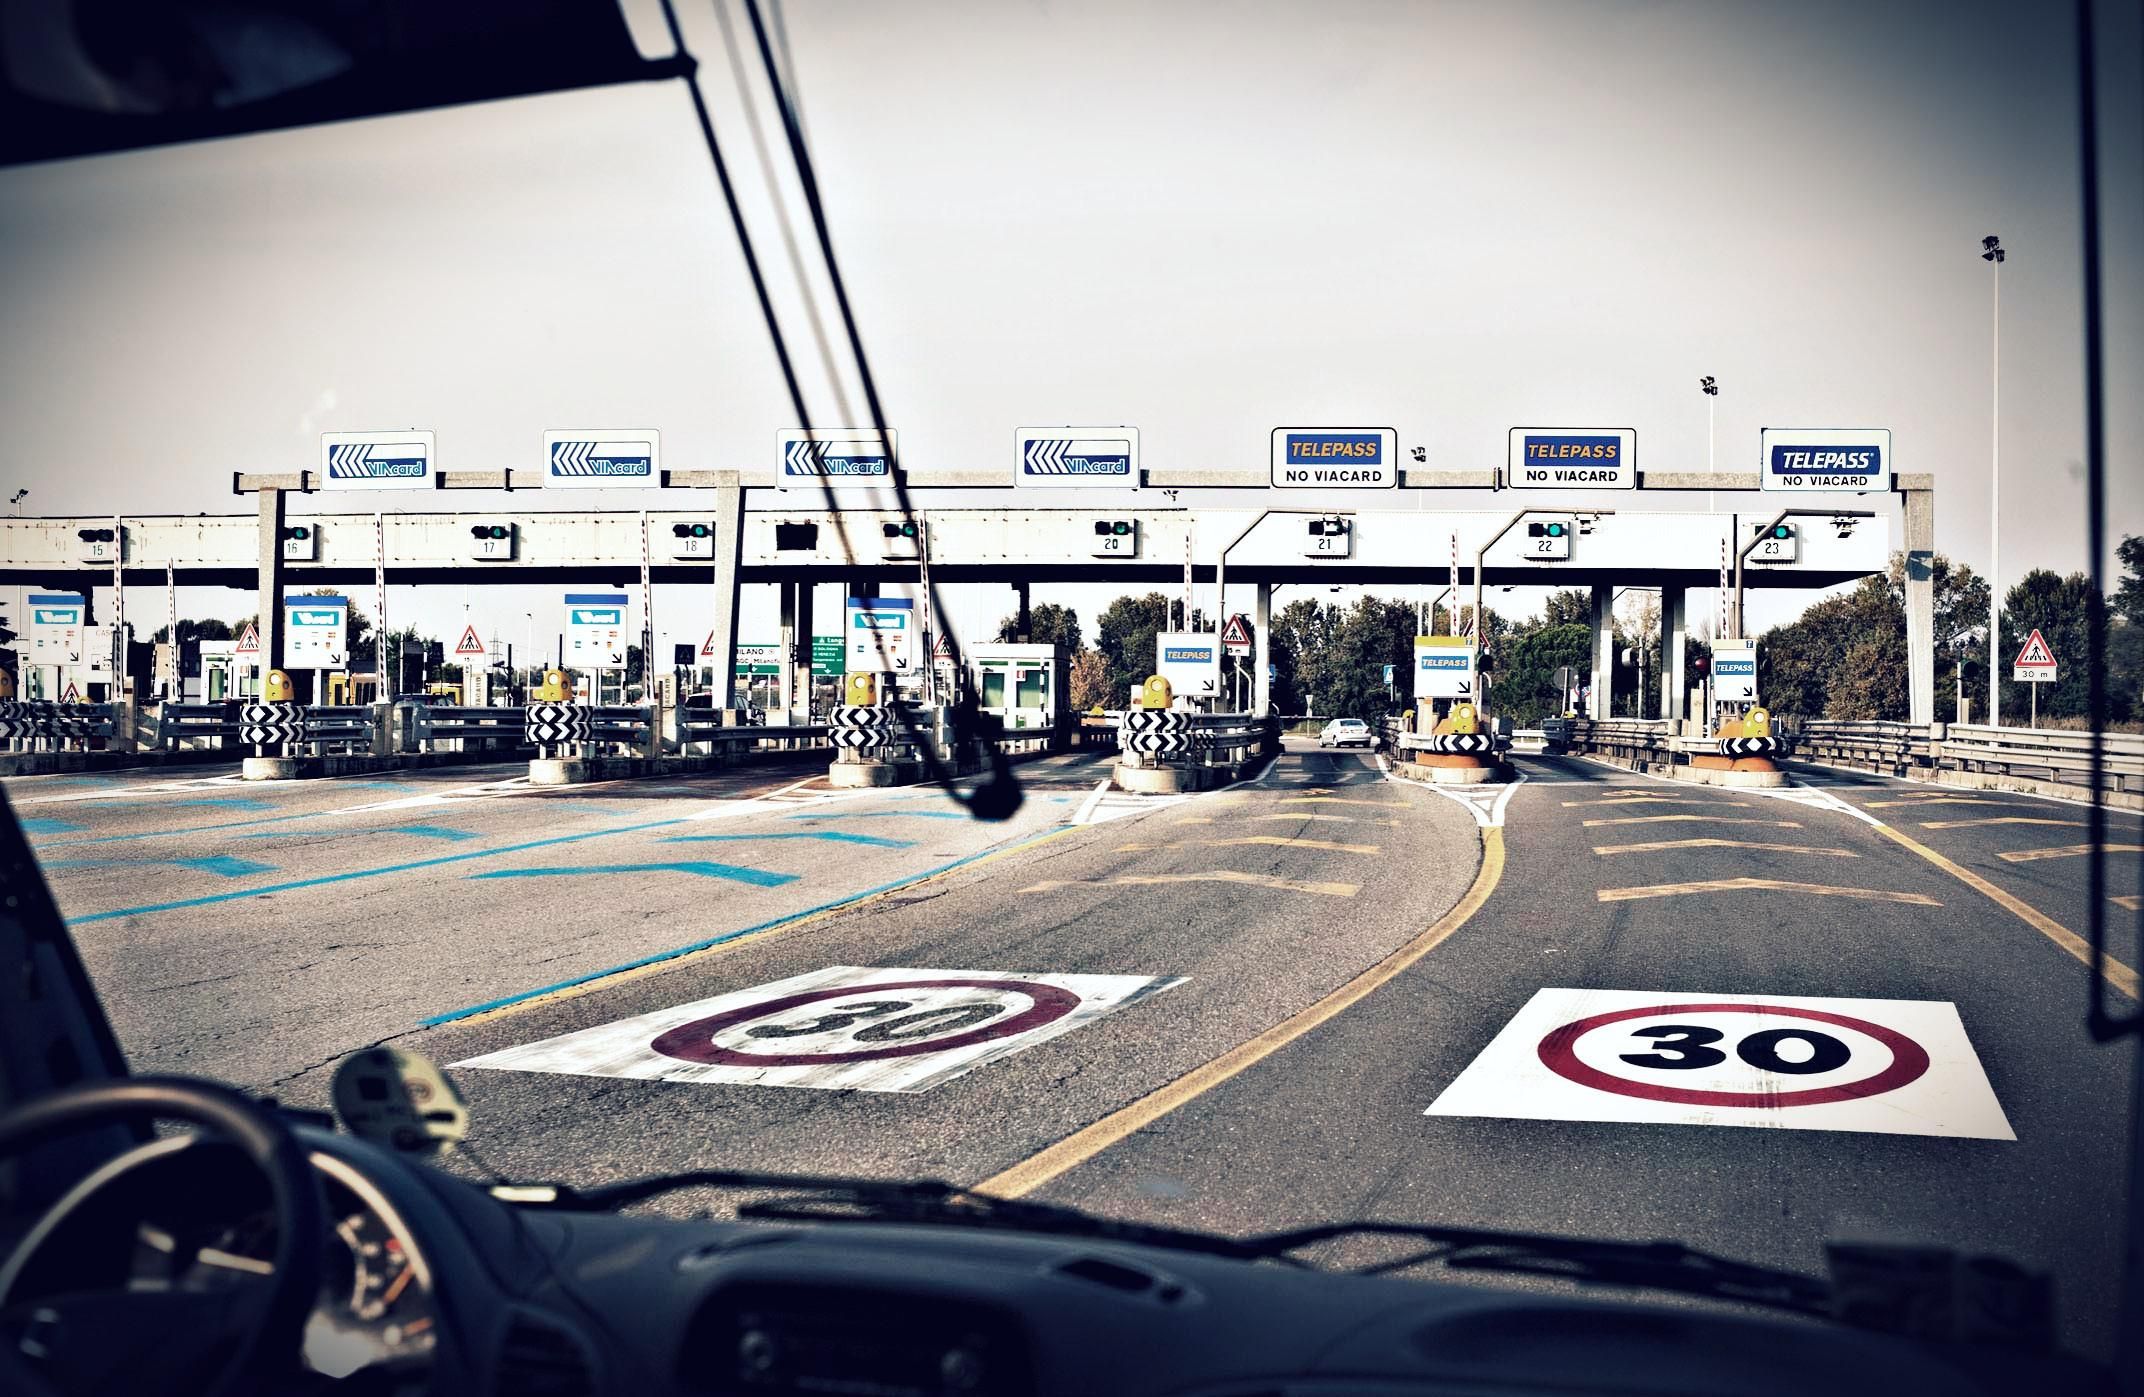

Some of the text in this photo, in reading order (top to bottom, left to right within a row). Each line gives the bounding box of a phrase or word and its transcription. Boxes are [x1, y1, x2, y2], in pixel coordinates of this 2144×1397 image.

[1292, 442, 1377, 457] TELEPASS
[1528, 444, 1617, 458] TELEPASS
[1783, 452, 1870, 469] TELEPASS
[1286, 470, 1382, 482] NO VIACARD
[1526, 470, 1618, 482] NO VIACARD
[1783, 475, 1868, 486] NO VIACARD
[92, 544, 103, 556] 15
[287, 543, 298, 555] 16
[484, 542, 495, 553] 17
[685, 540, 698, 552] 18
[1104, 538, 1119, 550] 20
[1318, 538, 1331, 550] 21
[1538, 540, 1553, 552] 22
[1765, 542, 1779, 555] 23
[1168, 651, 1210, 660] TELEPASS
[1423, 659, 1467, 667] TELEPASS
[1717, 664, 1753, 672] TELEPASS
[2022, 670, 2035, 678] 30
[745, 1000, 1007, 1042] 30
[1618, 1024, 1852, 1075] 30
